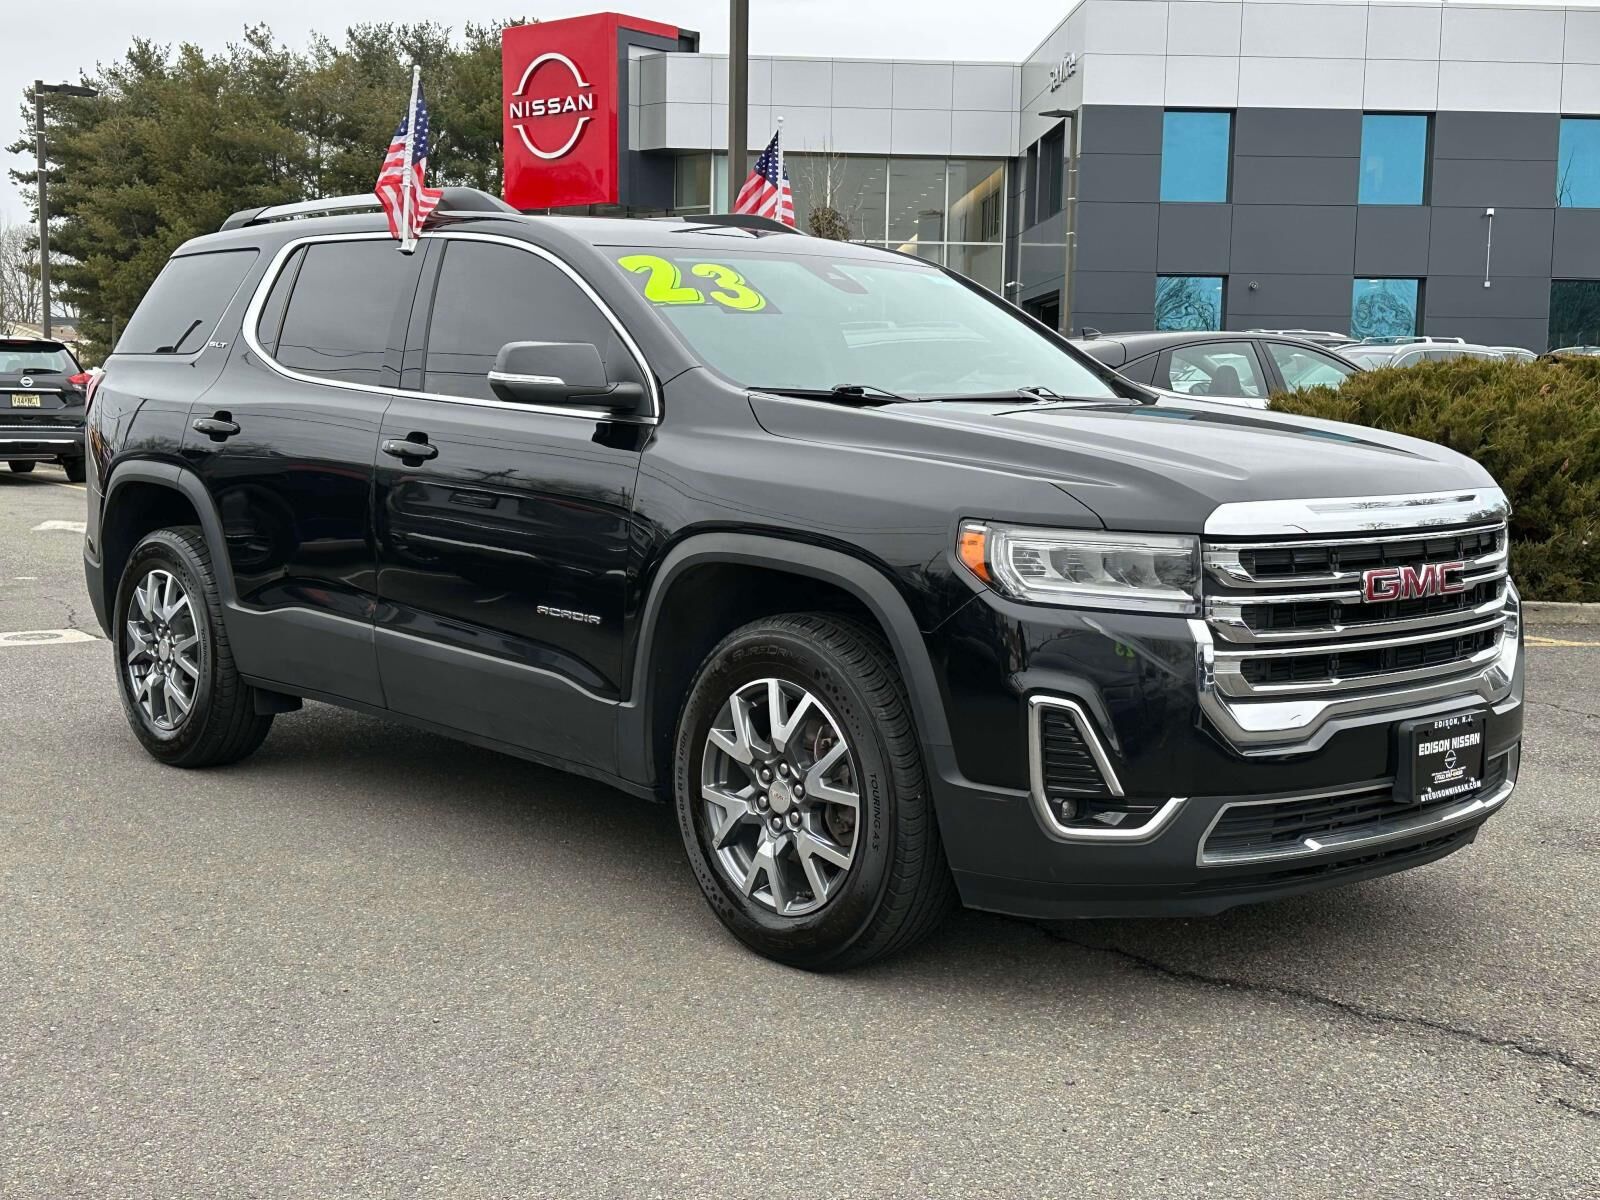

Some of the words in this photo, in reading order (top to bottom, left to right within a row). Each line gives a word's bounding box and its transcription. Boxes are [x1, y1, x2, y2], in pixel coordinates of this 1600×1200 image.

[509, 93, 593, 119] NISSAN
[617, 255, 766, 312] 23
[209, 341, 228, 349] SLT
[1363, 561, 1464, 603] GMC
[536, 605, 601, 625] ACADIA
[1434, 718, 1460, 729] EDISON,
[1418, 739, 1450, 756] EDISON
[1451, 732, 1480, 750] NISSAN
[869, 773, 881, 829] TOURING
